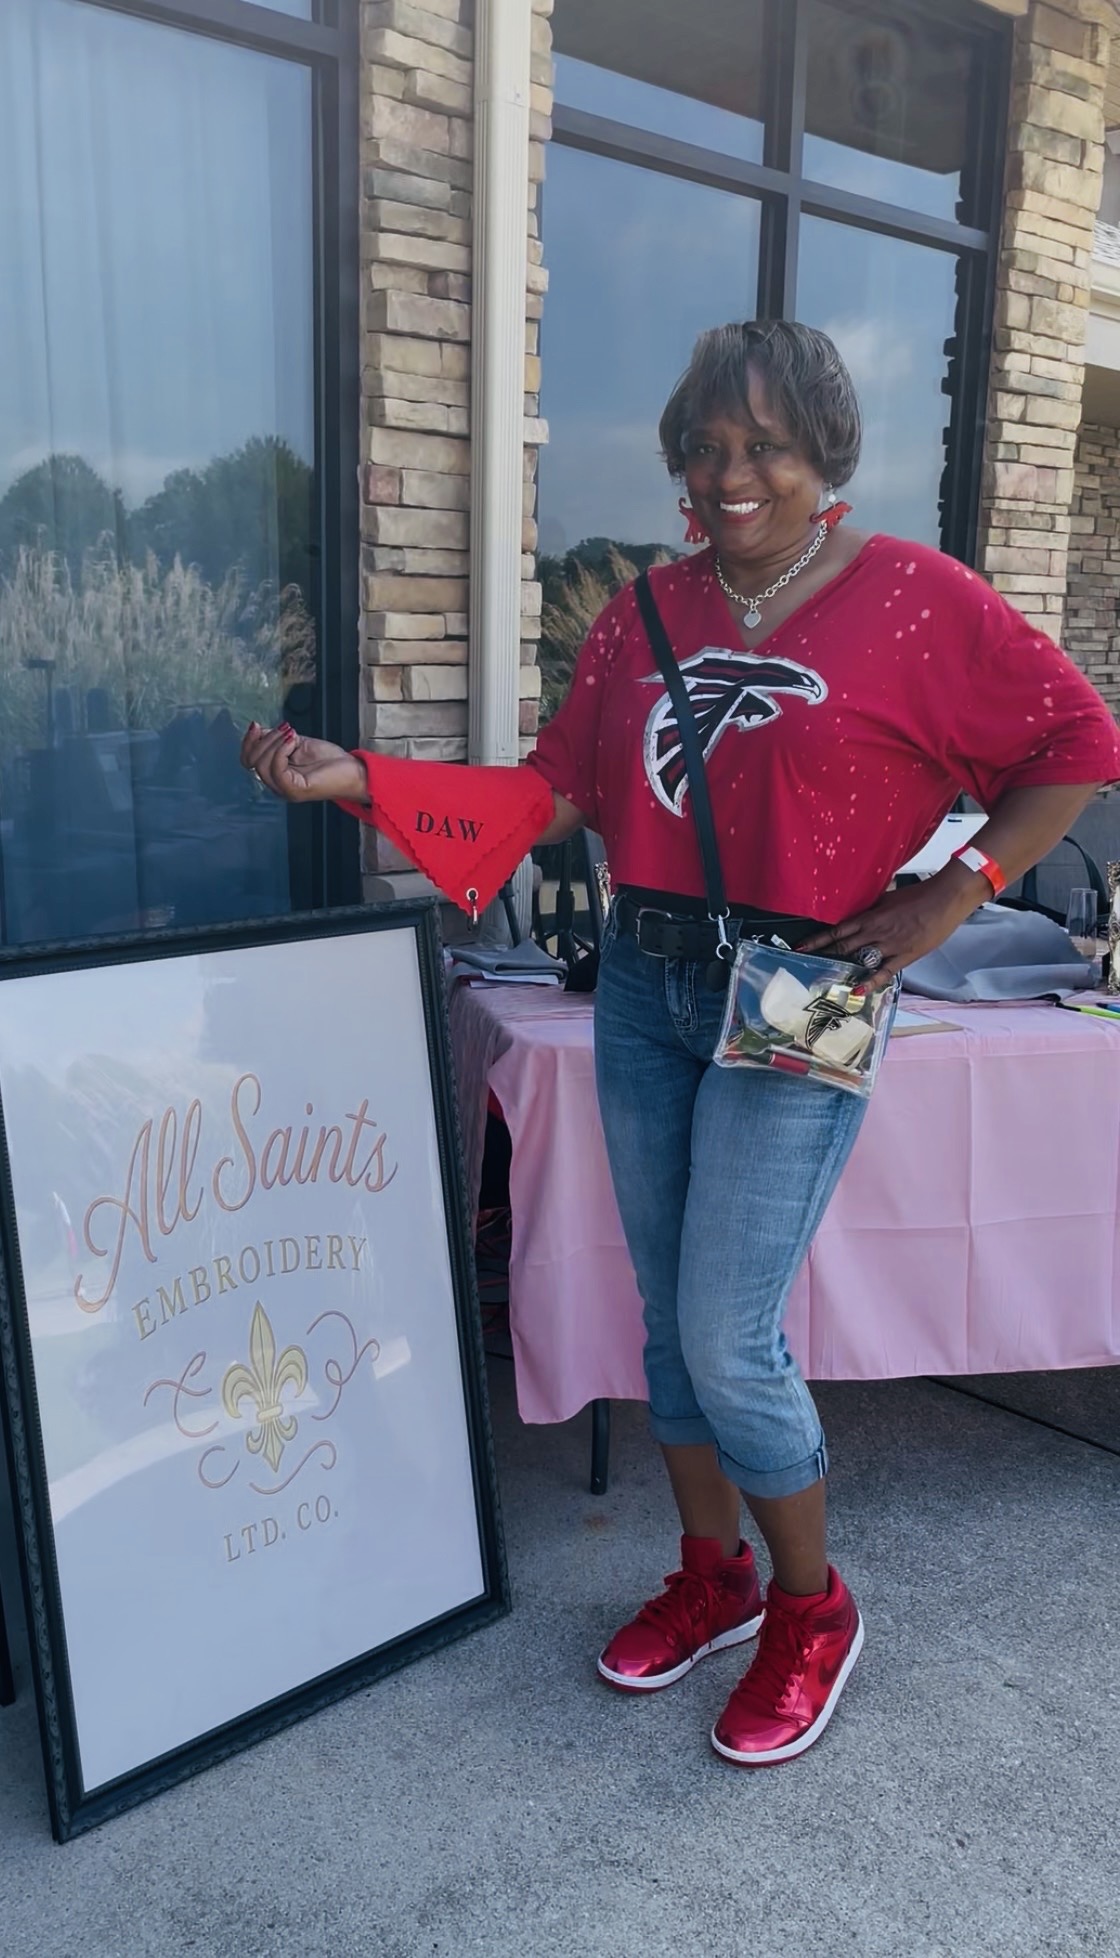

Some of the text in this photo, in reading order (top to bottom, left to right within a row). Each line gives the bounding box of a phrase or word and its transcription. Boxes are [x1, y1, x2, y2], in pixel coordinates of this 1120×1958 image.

[415, 810, 485, 843] DAW
[74, 1072, 398, 1313] All Saints
[131, 1234, 367, 1341] EMBROIDERY
[223, 1495, 339, 1562] LTD. CO.
